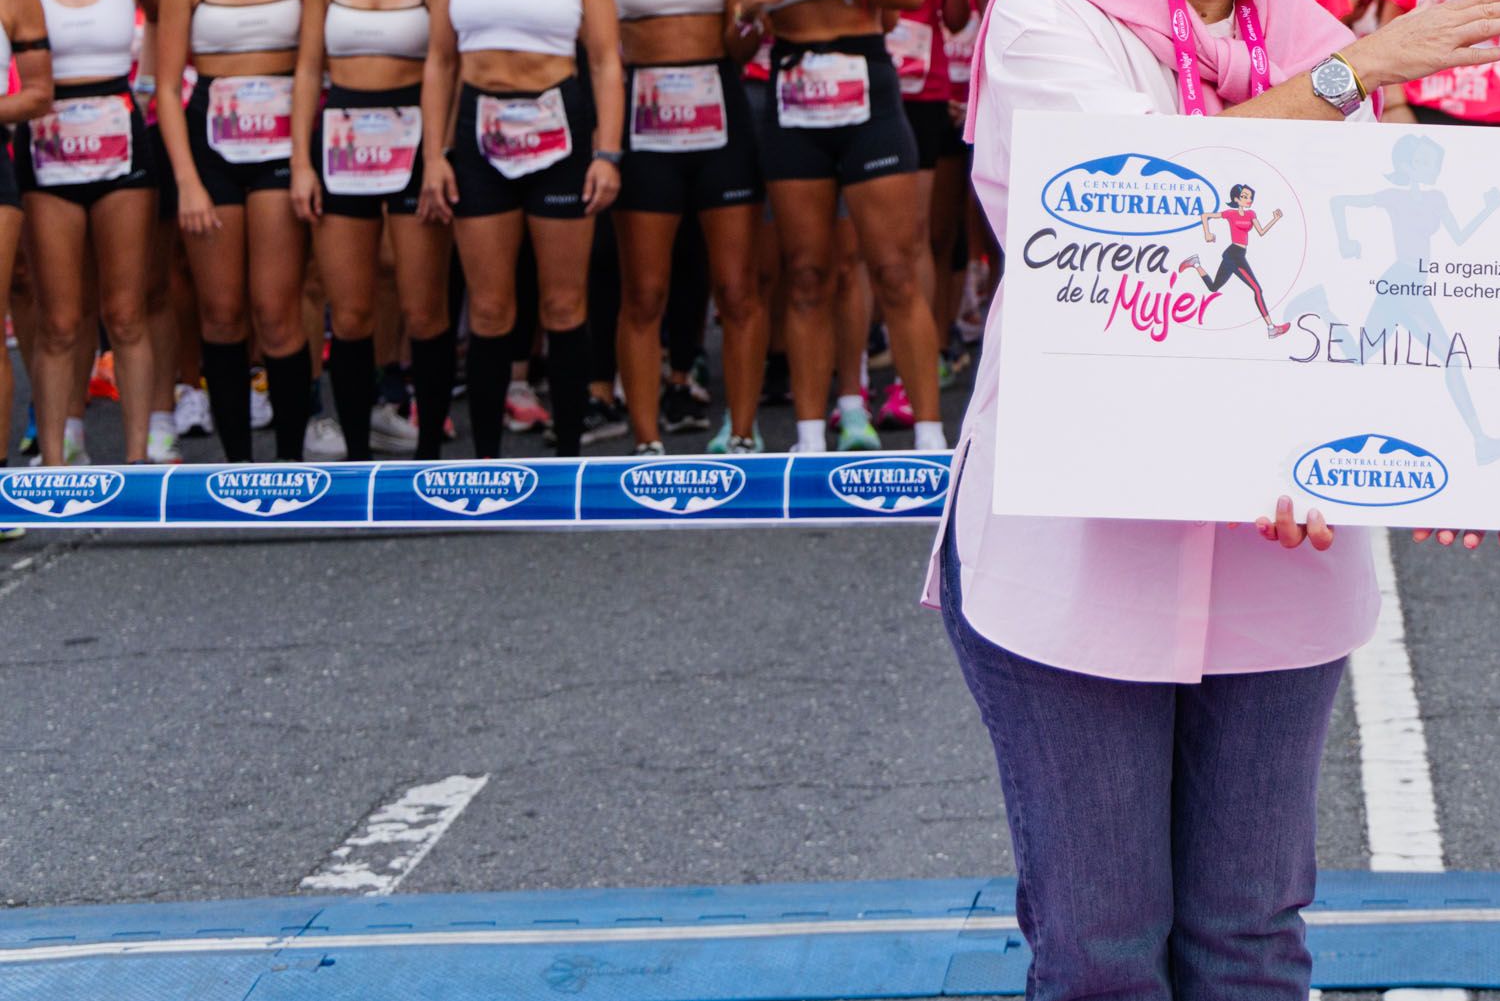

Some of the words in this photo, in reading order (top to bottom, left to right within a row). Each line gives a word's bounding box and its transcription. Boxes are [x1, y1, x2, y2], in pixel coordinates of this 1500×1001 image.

[62, 134, 102, 154] 016
[1083, 180, 1138, 190] CENTRAL
[1144, 182, 1201, 192] LECHERA
[1054, 181, 1205, 216] ASTURIANA
[1023, 227, 1170, 273] Carrera
[1418, 258, 1440, 274] La
[1056, 274, 1083, 303] de
[1090, 275, 1110, 304] la
[1103, 271, 1223, 342] Mujer
[1304, 458, 1437, 490] ASTURIANA
[1329, 457, 1378, 466] CENTRAL
[1382, 459, 1433, 468] LECHERA
[11, 472, 115, 496] ASTURIANA
[218, 471, 322, 495] ASTURIANA
[424, 470, 529, 493] ASTURIANA
[631, 468, 738, 492] ASTURIANA
[838, 467, 944, 491] ASTURIANA
